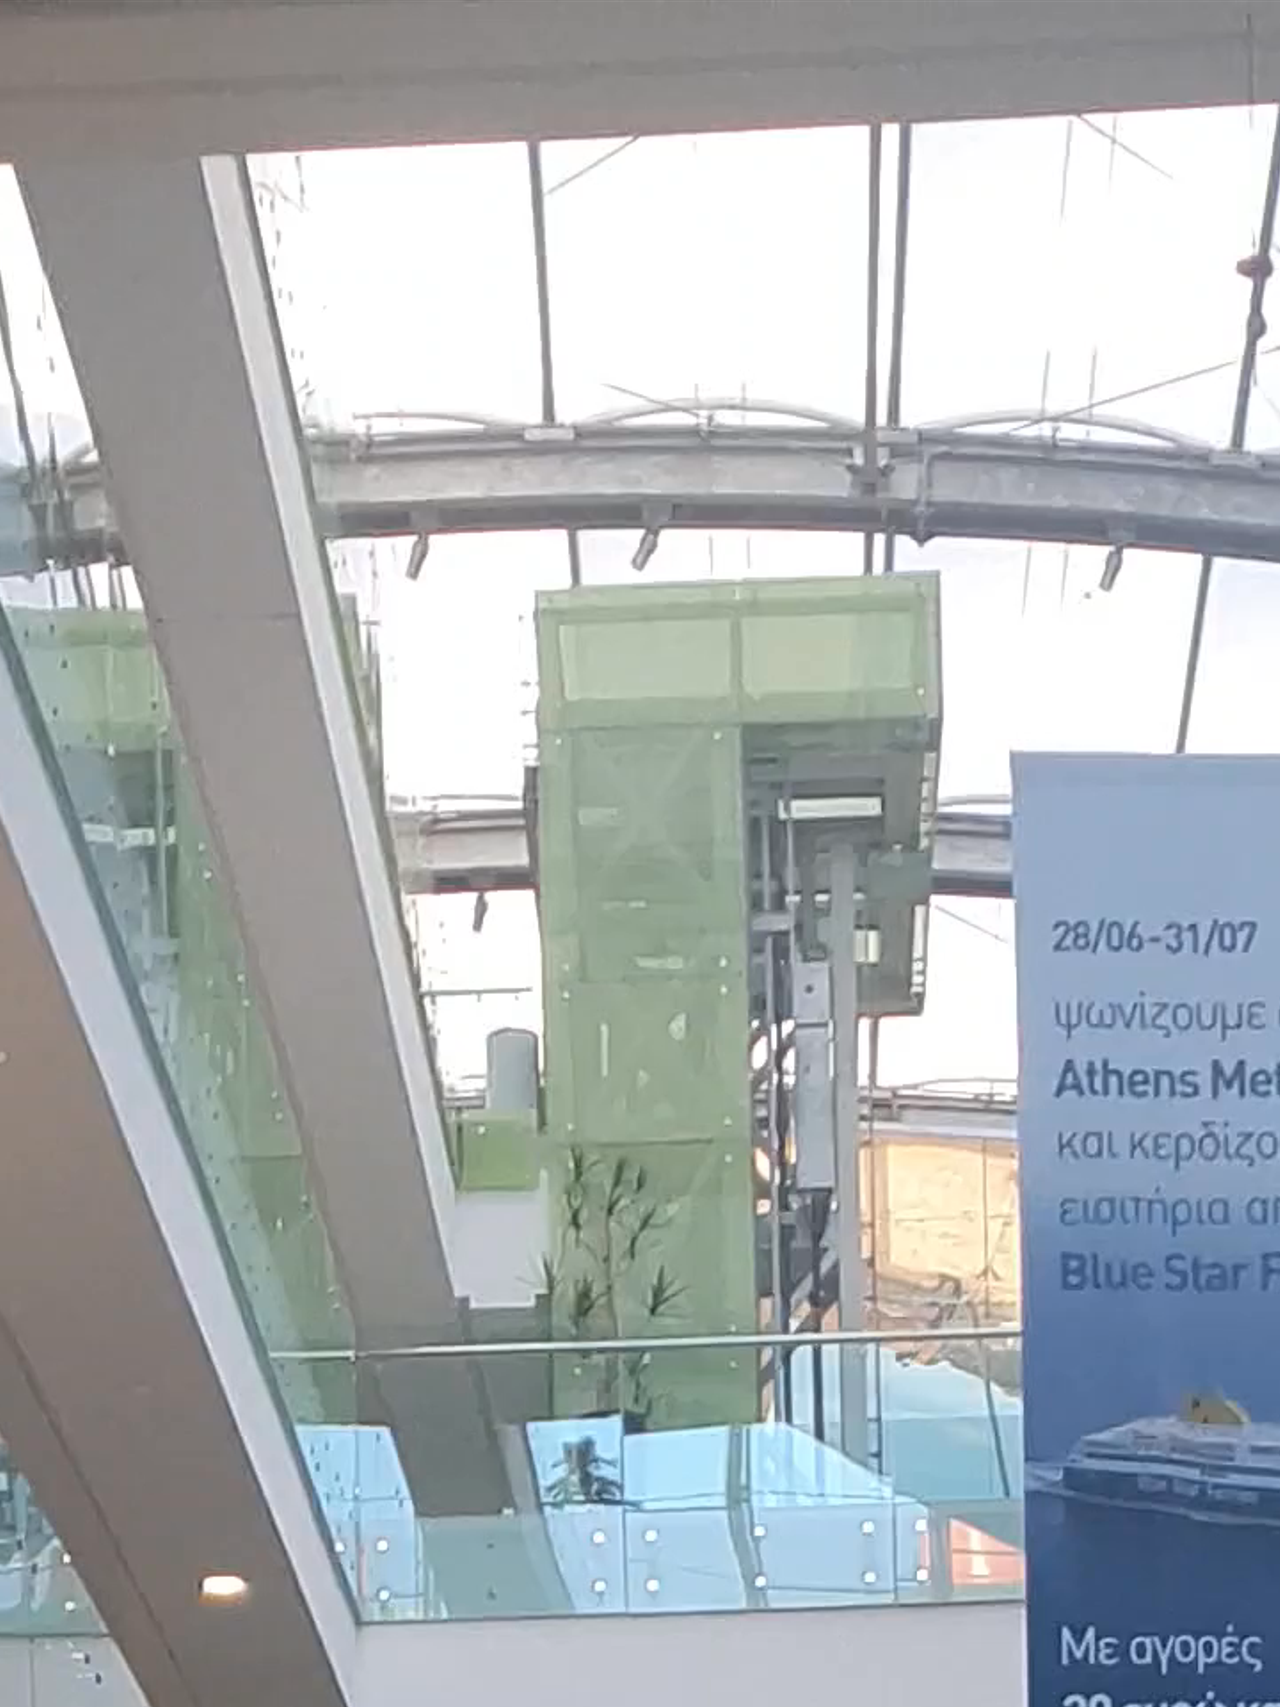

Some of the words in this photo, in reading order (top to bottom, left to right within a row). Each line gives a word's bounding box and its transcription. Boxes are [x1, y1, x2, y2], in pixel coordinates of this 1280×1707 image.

[1051, 920, 1258, 955] 28/06-31/07
[1052, 990, 1266, 1040] ψωνίζουμε
[1055, 1059, 1201, 1099] Athens
[1057, 1129, 1118, 1160] και
[1060, 1252, 1154, 1292] Blue
[1165, 1252, 1248, 1292] Star
[1059, 1628, 1120, 1667] Με
[1129, 1623, 1264, 1676] αγορές
